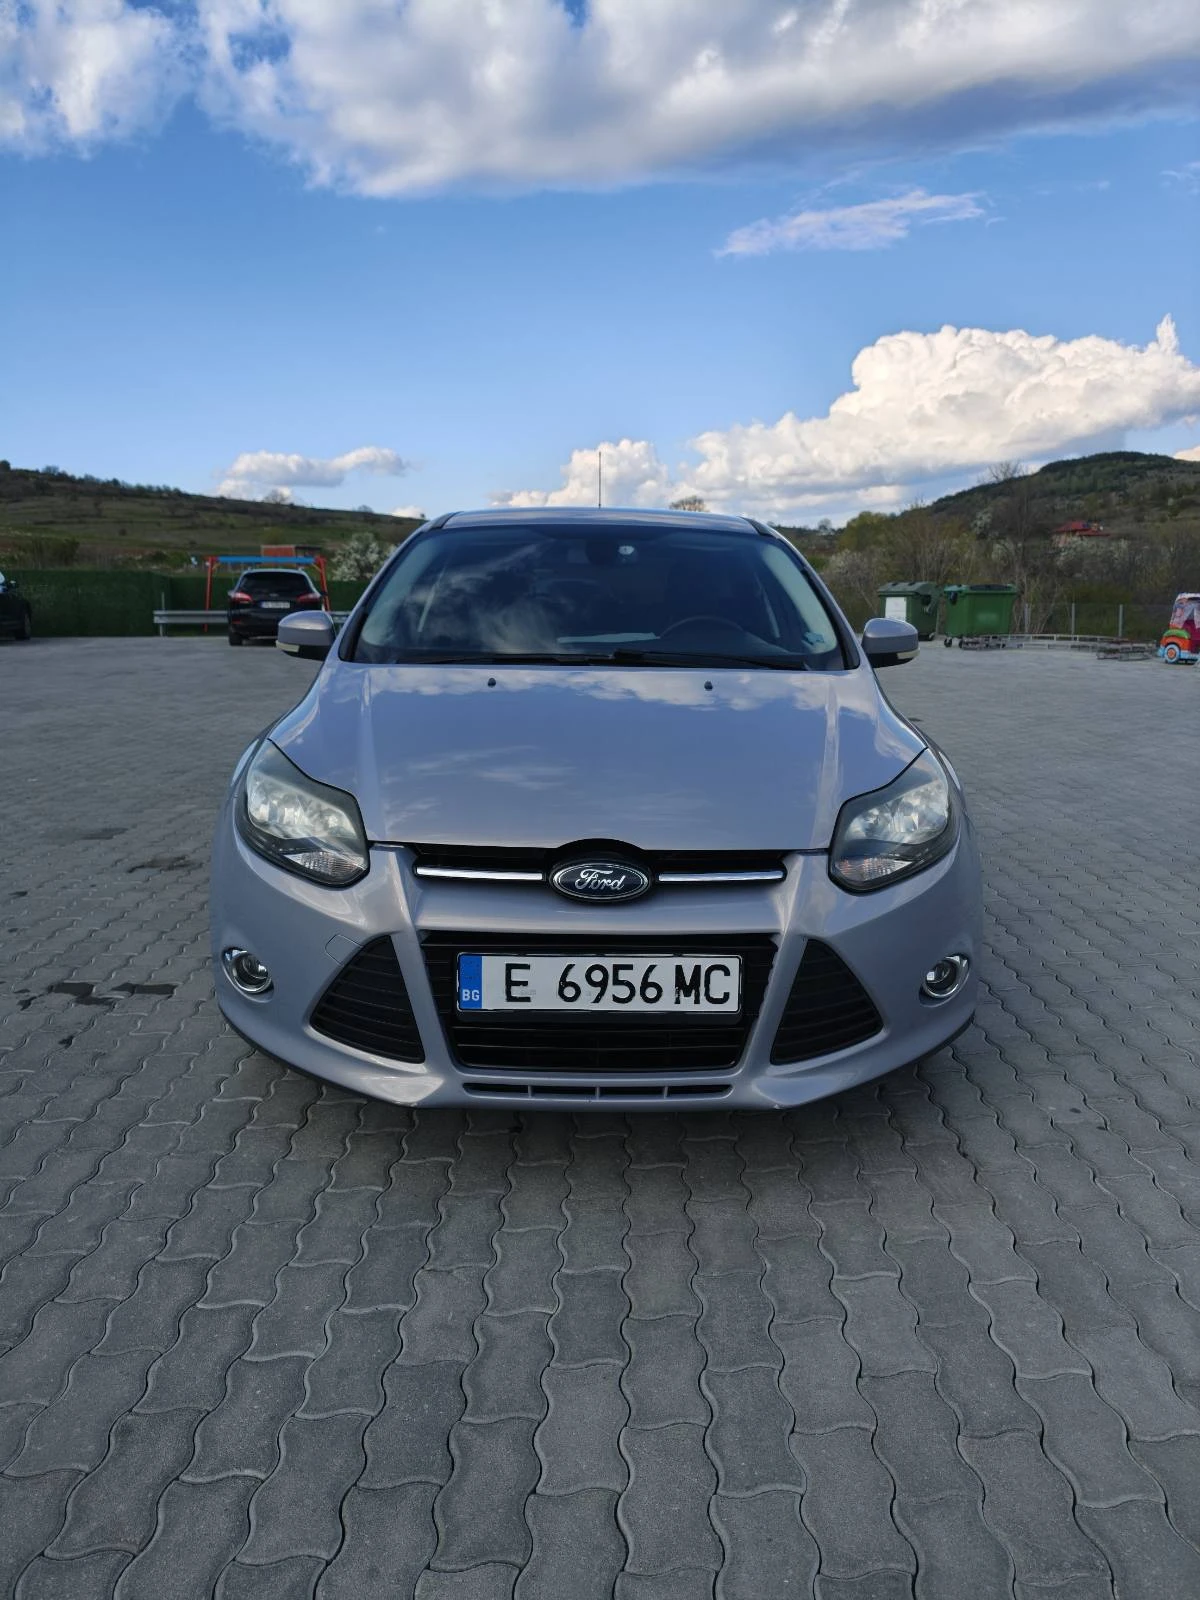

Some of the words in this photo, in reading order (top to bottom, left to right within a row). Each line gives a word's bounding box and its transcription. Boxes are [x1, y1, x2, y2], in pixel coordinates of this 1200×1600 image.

[575, 868, 626, 890] Ford
[462, 989, 480, 1001] BG
[504, 963, 531, 1003] E
[558, 963, 663, 1004] 6956
[674, 964, 731, 1005] MC
